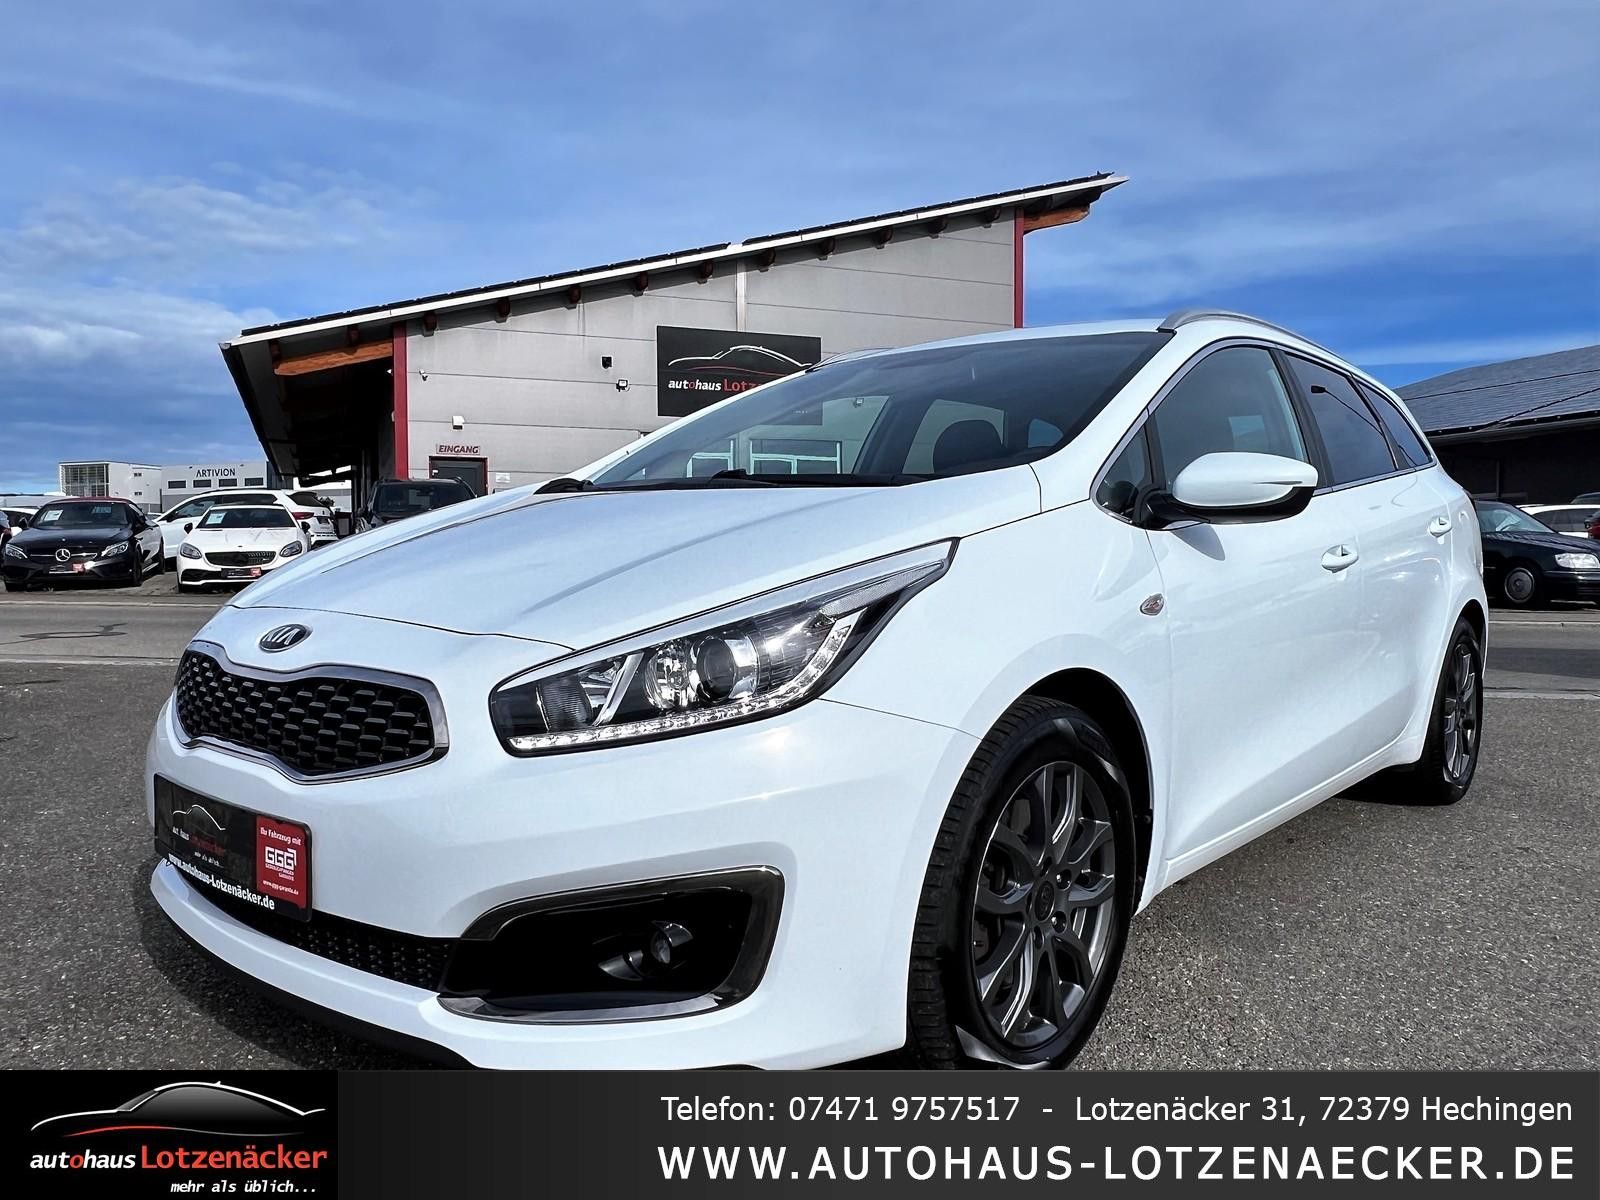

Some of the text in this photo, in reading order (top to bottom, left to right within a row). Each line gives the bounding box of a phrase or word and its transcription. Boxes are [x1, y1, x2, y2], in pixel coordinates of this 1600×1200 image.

[668, 379, 722, 391] autohaus
[438, 444, 479, 454] EINGANG
[196, 468, 236, 478] ARTIVION
